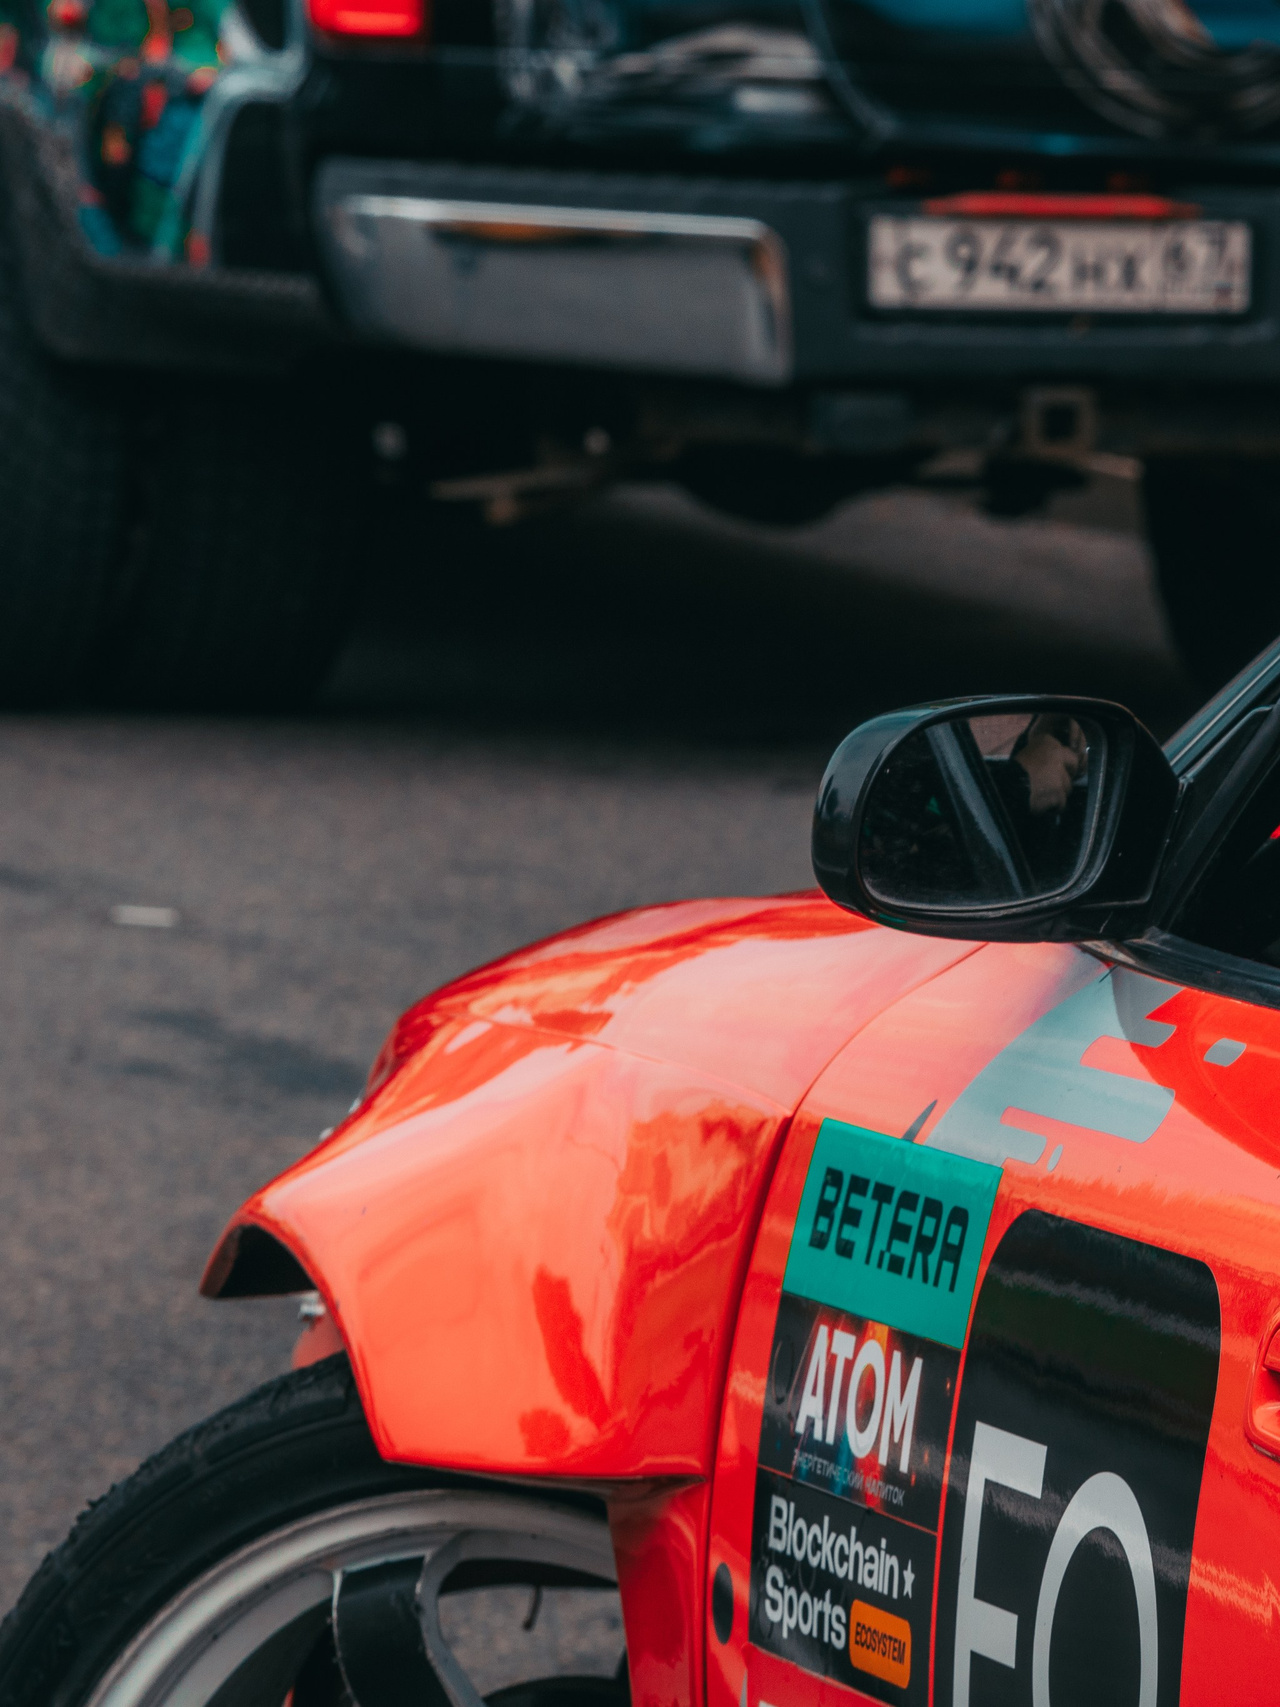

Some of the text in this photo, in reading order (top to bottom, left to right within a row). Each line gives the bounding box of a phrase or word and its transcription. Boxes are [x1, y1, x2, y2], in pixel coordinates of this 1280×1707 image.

[865, 1474, 905, 1507] НАПИТОК
[768, 1494, 900, 1599] Blockchain
[765, 1564, 906, 1666] Sports ECOSYSTEM
